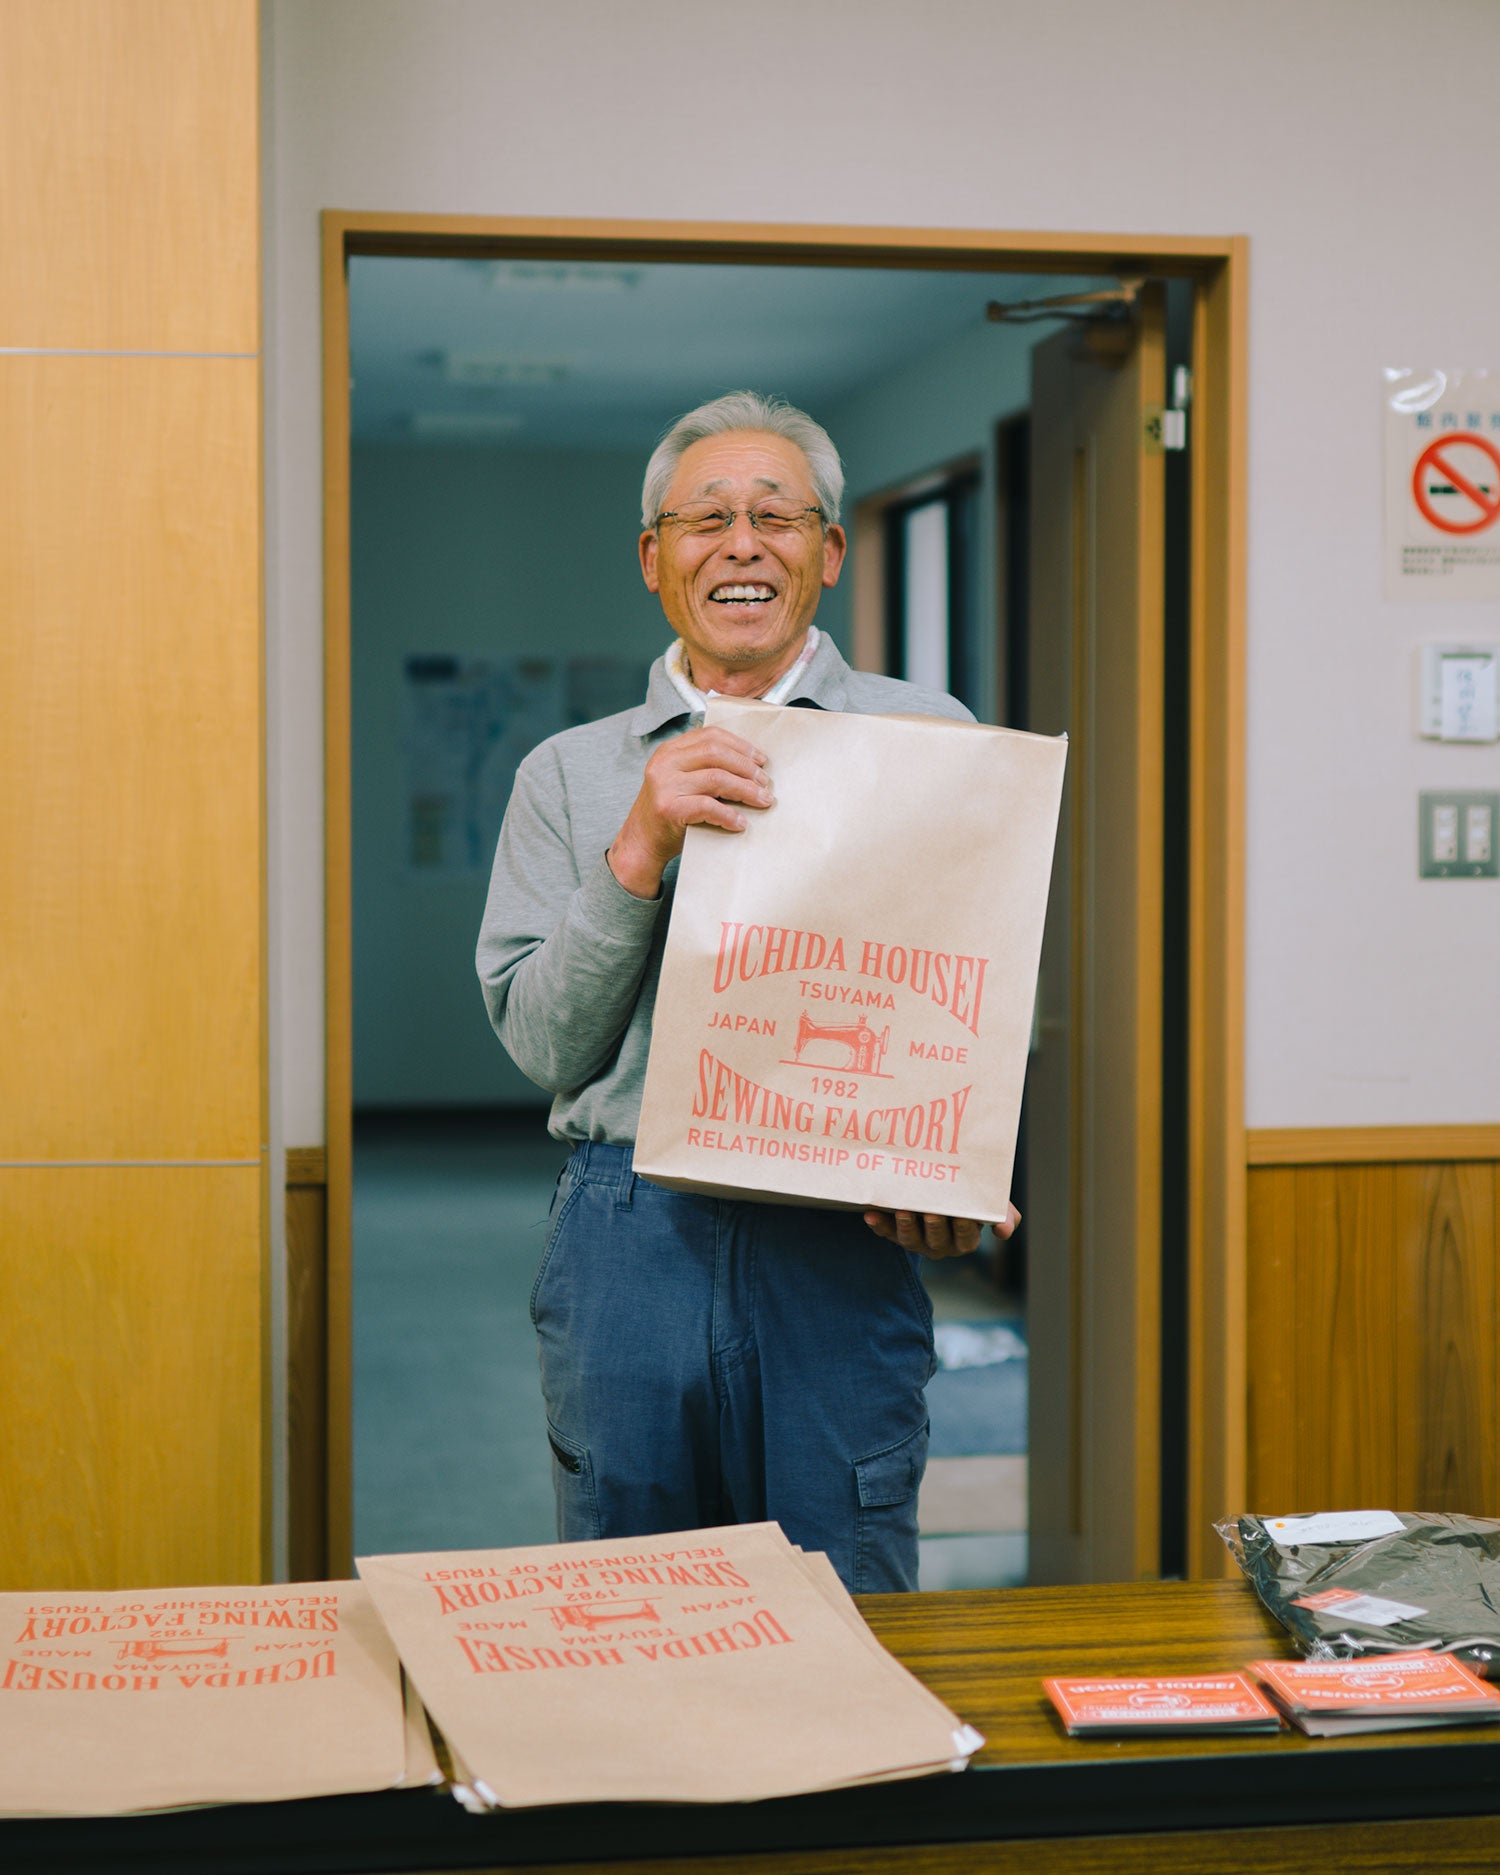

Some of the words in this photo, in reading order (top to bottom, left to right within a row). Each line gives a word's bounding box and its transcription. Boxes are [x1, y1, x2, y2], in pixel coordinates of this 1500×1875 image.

[712, 921, 846, 994] UCHIDA
[858, 940, 989, 1039] HOUSEI
[799, 980, 896, 1011] TSUYAMA
[707, 1011, 777, 1037] JAPAN
[908, 1040, 969, 1065] MADE
[811, 1075, 859, 1100] 1982
[691, 1047, 815, 1134] SEWING
[822, 1084, 973, 1155] FACTORY
[687, 1128, 850, 1167] RELATIONSHIP
[856, 1152, 884, 1171] OF
[892, 1156, 961, 1183] TRUST
[508, 1562, 543, 1577] OF
[548, 1546, 725, 1572] RELATIONSHIP
[422, 1566, 501, 1583] TRUST
[599, 1560, 750, 1589] SEWING
[153, 1596, 338, 1611] RELATIONSHIP
[431, 1566, 590, 1616] FACTORY
[563, 1589, 620, 1603] 1982
[24, 1604, 104, 1615] TRUST
[112, 1603, 143, 1614] OF
[680, 1594, 757, 1615] JAPAN
[14, 1612, 186, 1644] FACTORY
[149, 1627, 205, 1639] 1982
[199, 1608, 339, 1633] SEWING
[458, 1620, 527, 1632] MADE
[254, 1638, 335, 1653] JAPAN
[559, 1627, 677, 1646] TSUYAMA
[635, 1608, 795, 1663] UCHIDA
[20, 1649, 92, 1658] MADE
[453, 1634, 626, 1674] HOUSEI
[0, 1658, 160, 1692] HOUSEI
[112, 1662, 232, 1672] TSUYAMA
[176, 1649, 337, 1690] UCHIDA
[1069, 1682, 1150, 1694] UCHIDA
[1388, 1684, 1467, 1699] UCHIDA
